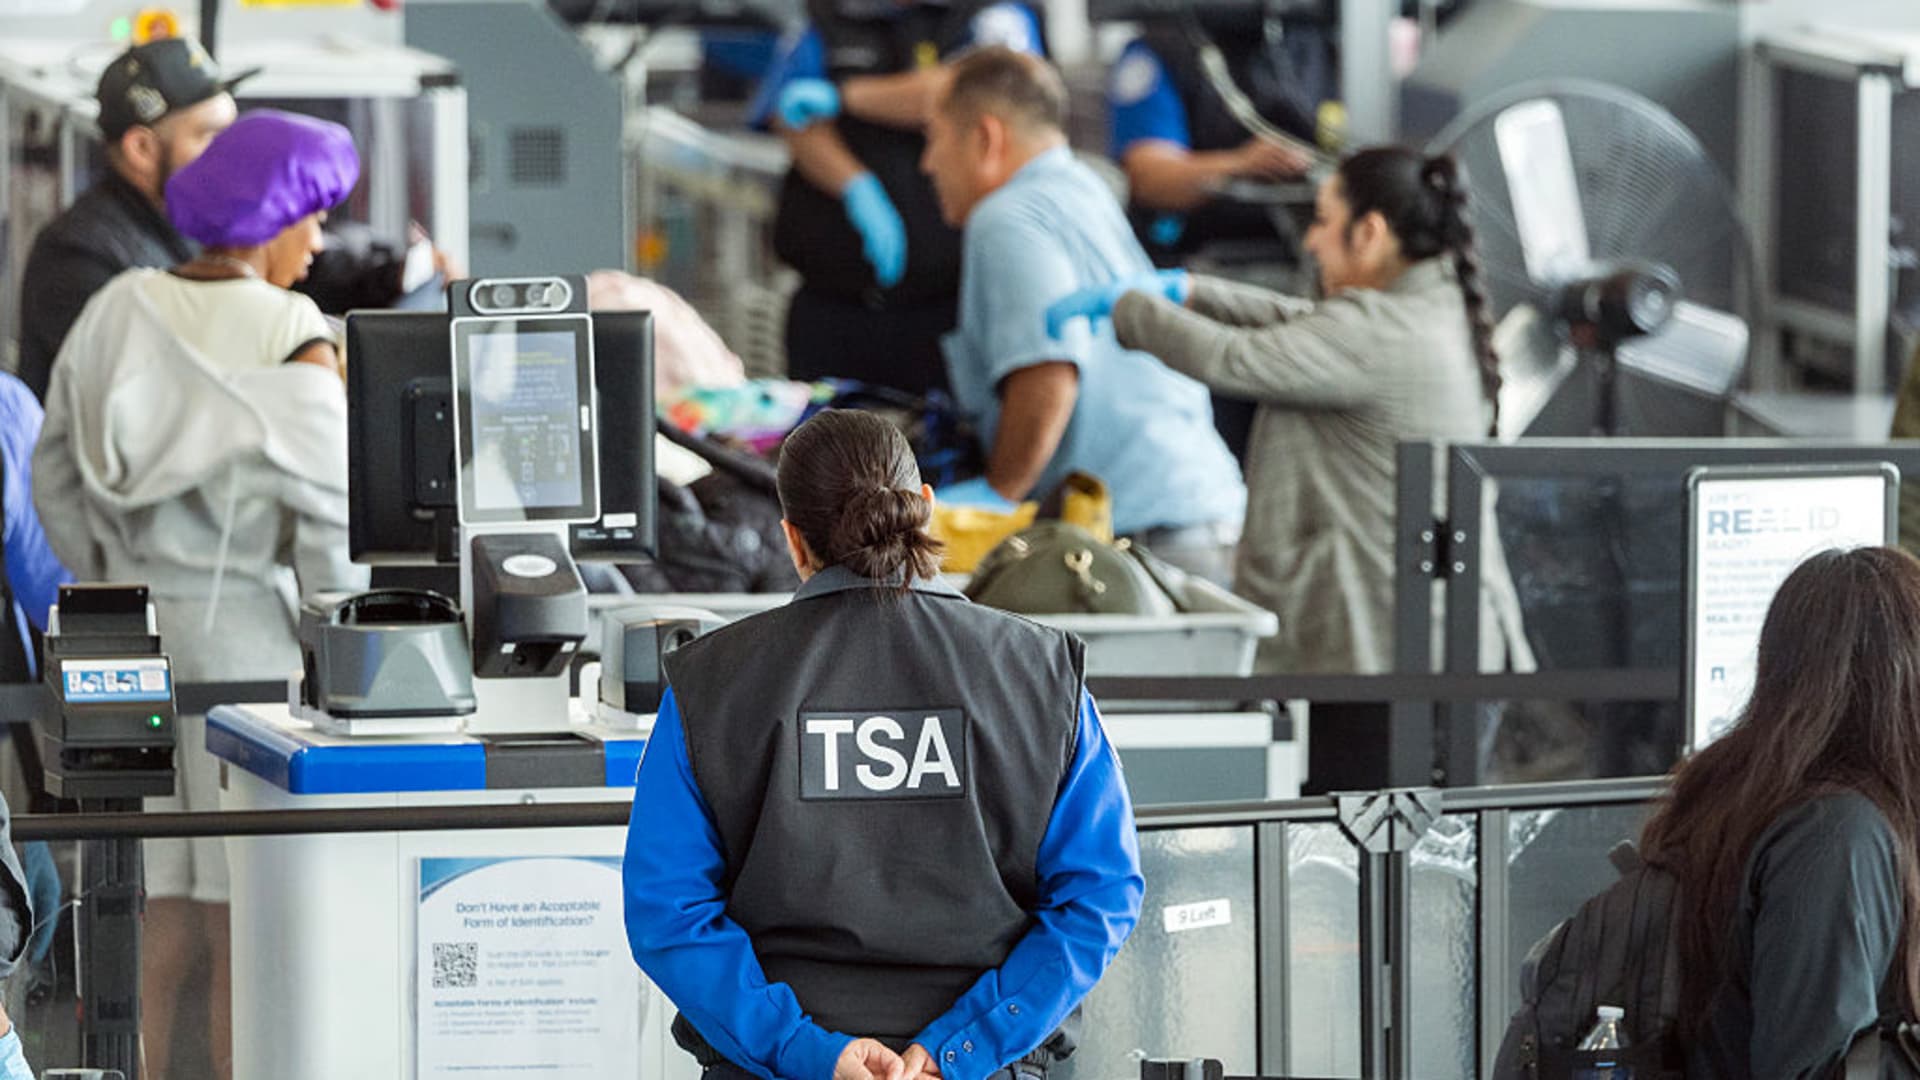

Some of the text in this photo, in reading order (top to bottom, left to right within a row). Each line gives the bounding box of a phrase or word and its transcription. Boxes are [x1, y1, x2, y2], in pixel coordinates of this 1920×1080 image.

[1808, 506, 1841, 531] ID
[806, 716, 960, 791] TSA
[456, 901, 601, 914] Don't Have an Acceptable
[1179, 905, 1217, 924] 9 Left
[463, 915, 595, 929] Form of Identification?
